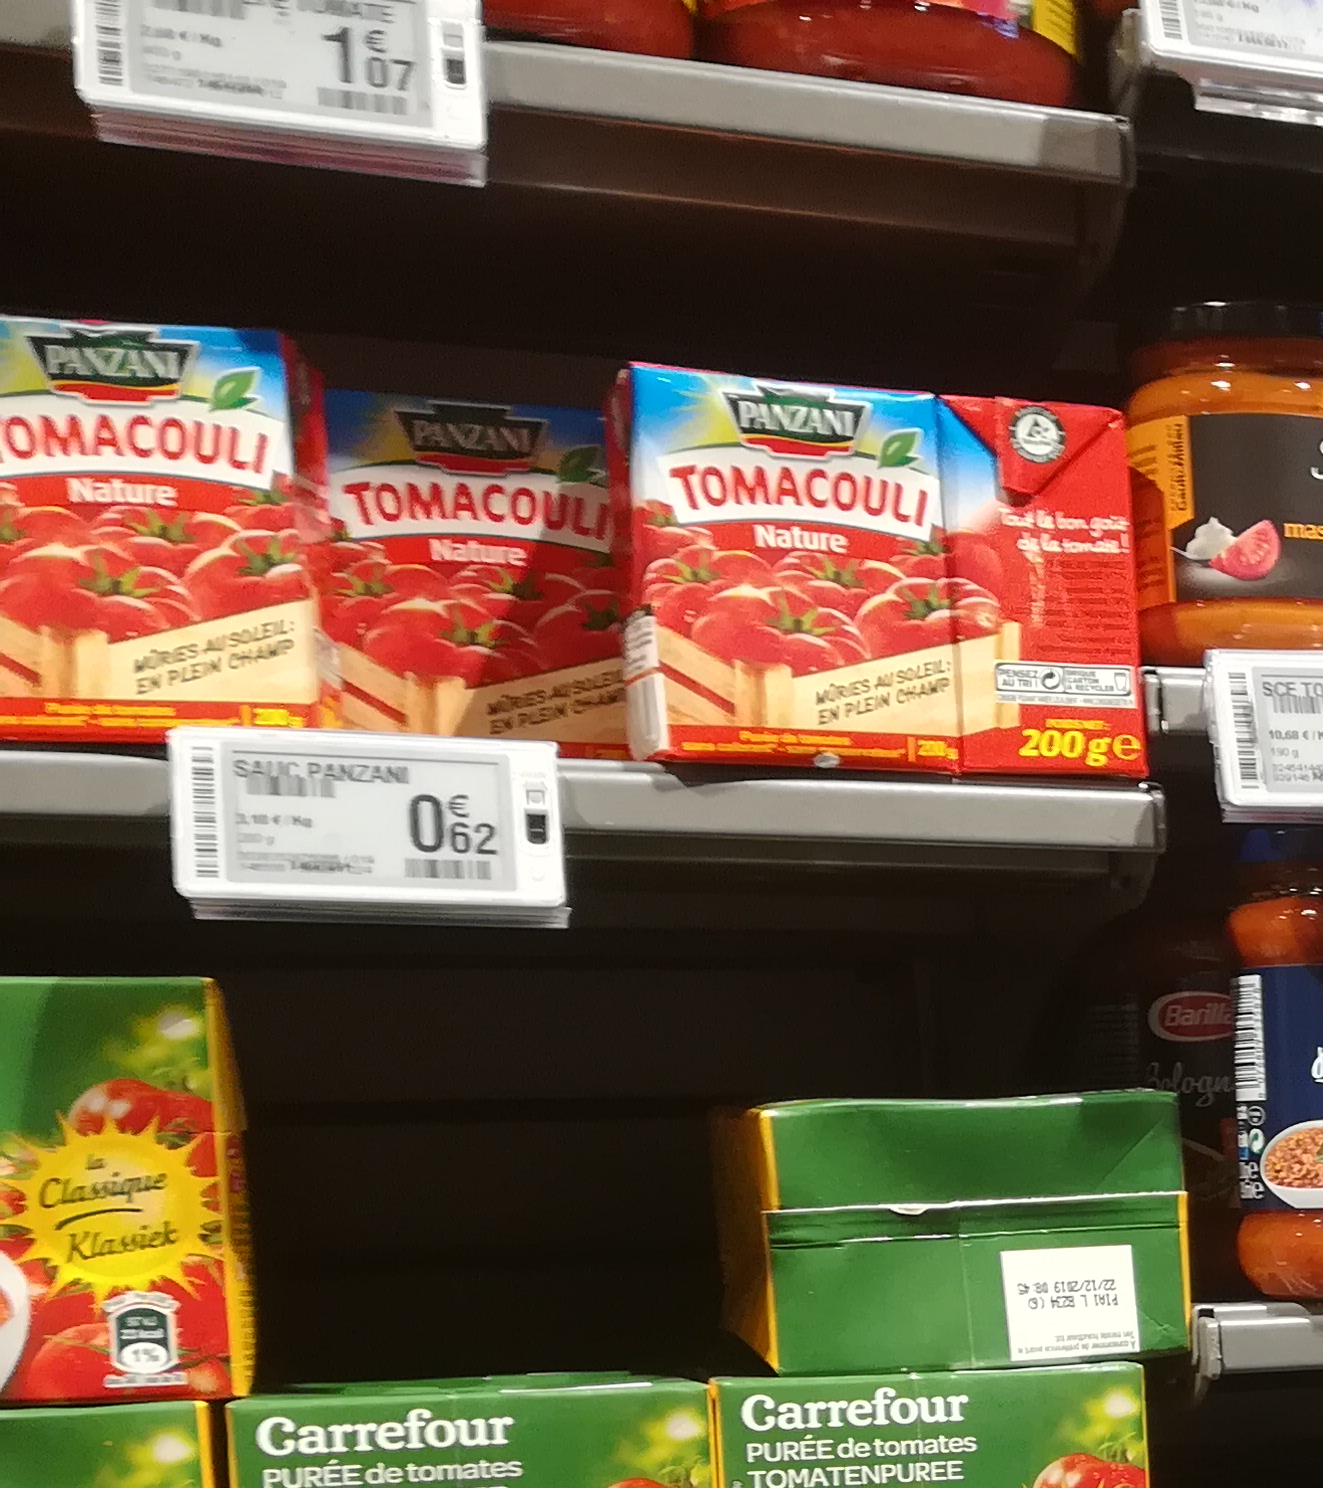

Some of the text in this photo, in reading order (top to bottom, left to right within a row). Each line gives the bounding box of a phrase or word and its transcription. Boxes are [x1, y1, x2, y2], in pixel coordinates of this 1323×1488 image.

[45, 342, 183, 380] PANZANI
[740, 401, 856, 440] PANZANI
[0, 413, 269, 473] OMACOULI
[68, 478, 178, 508] Nature
[345, 482, 608, 541] TOMACOULI
[669, 465, 927, 527] TOMACOULI
[429, 537, 527, 566] Nature
[754, 525, 848, 553] Nature
[815, 678, 871, 706] MÛRIES
[875, 674, 892, 696] AU
[817, 680, 951, 725] EN PLEIN CHAMP
[1262, 680, 1304, 698] SCE
[39, 1171, 167, 1209] Classique
[66, 1222, 179, 1262] Klassiek
[741, 1387, 968, 1431] Carrefour
[256, 1411, 515, 1456] Carrefour
[747, 1434, 977, 1463] PURÉE de tomates
[367, 1463, 403, 1485] de
[406, 1459, 523, 1483] tomates
